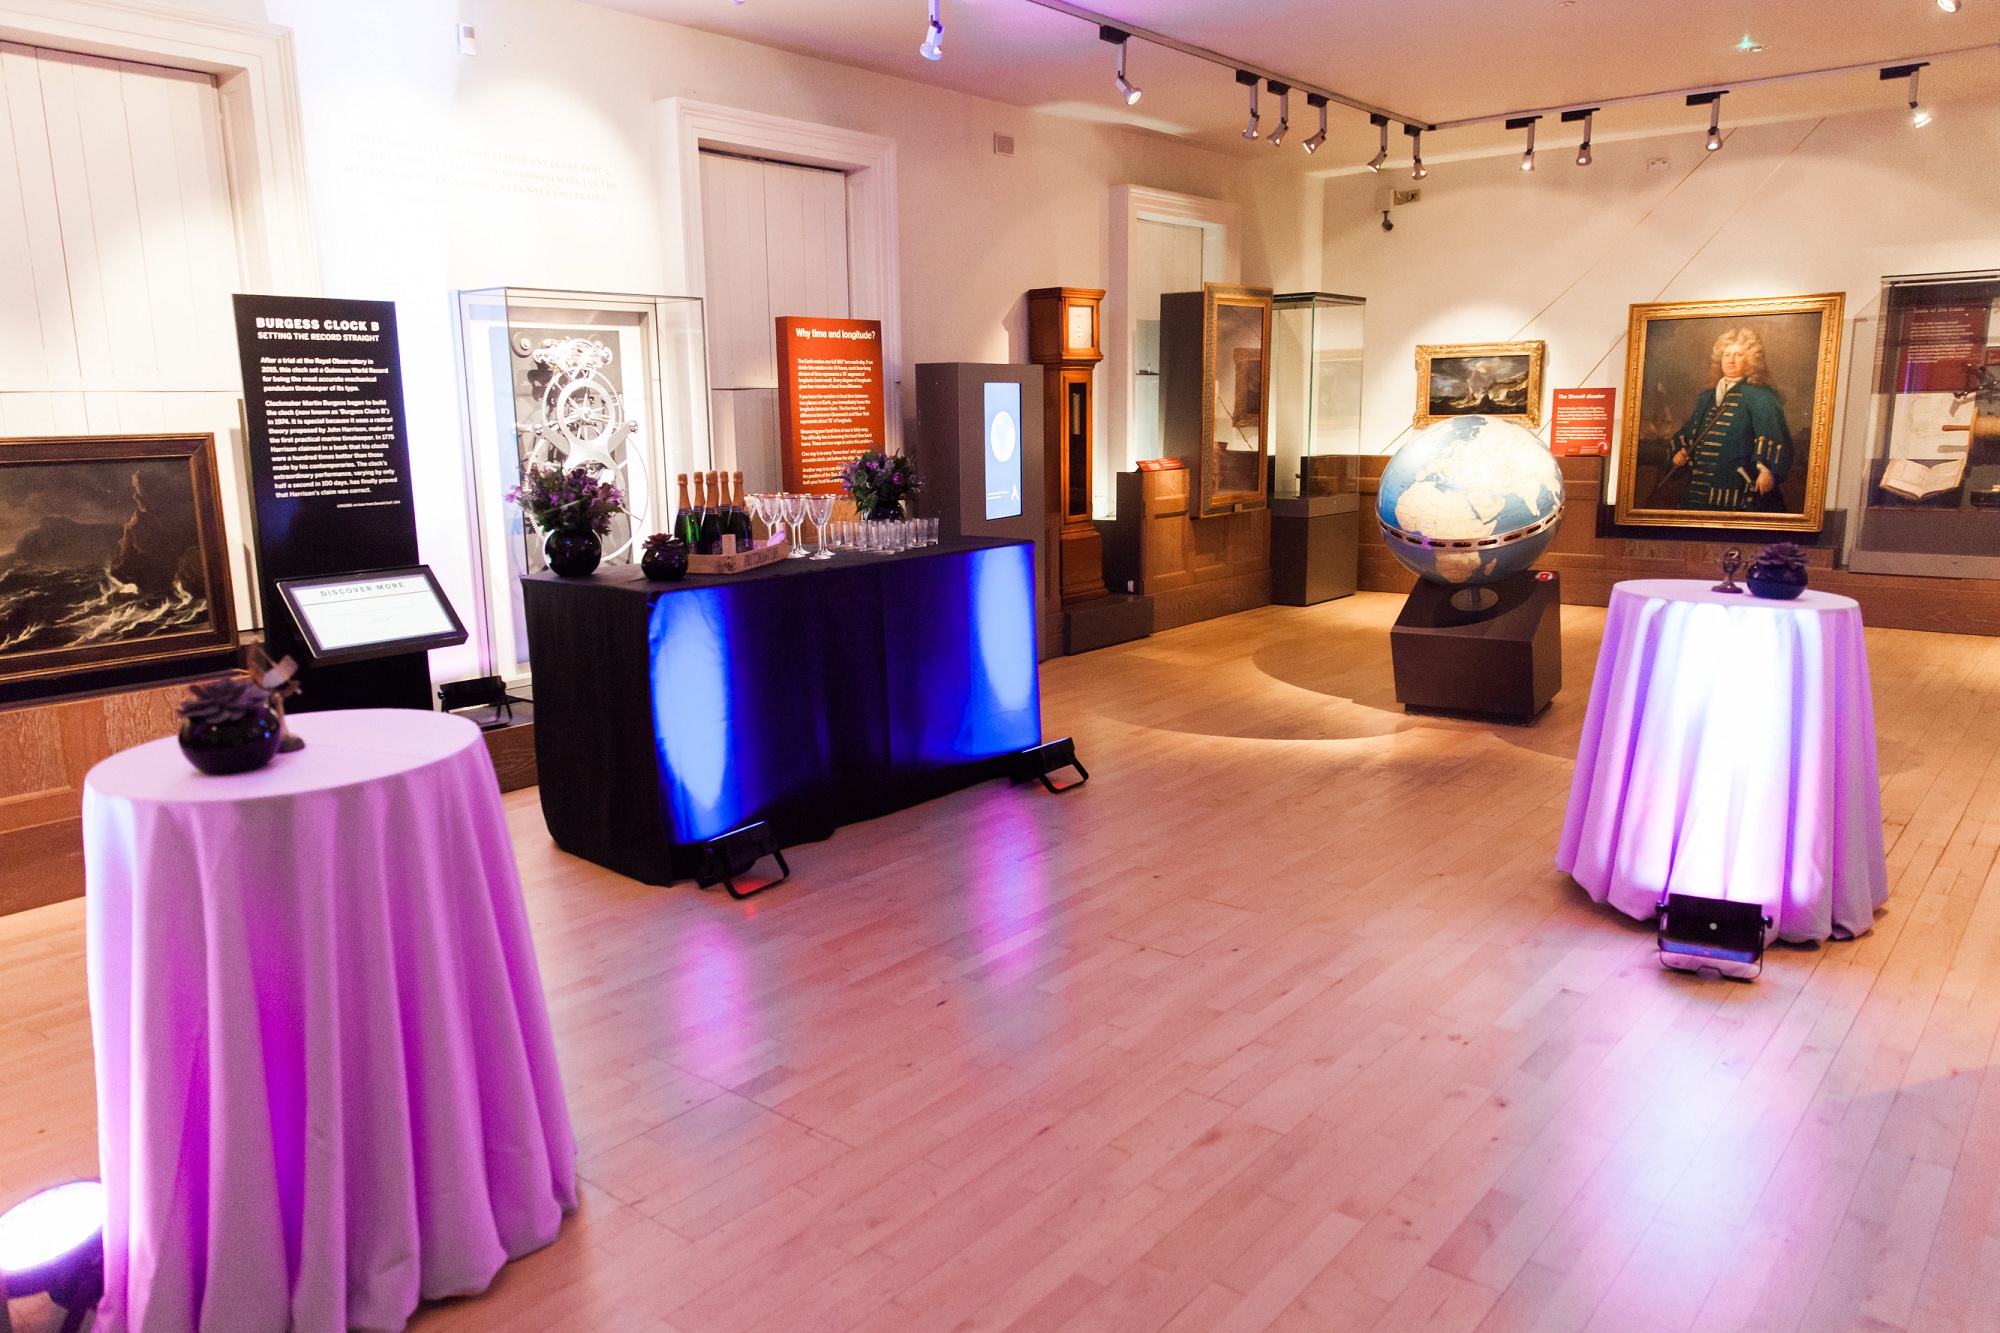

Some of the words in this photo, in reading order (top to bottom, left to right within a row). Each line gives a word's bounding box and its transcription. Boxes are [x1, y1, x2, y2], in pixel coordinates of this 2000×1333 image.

[492, 152, 527, 163] BEYOND
[551, 161, 577, 170] DOUBT
[580, 165, 602, 174] THAT
[557, 175, 581, 185] MADE
[583, 179, 599, 188] FOR
[601, 181, 617, 190] THE
[526, 186, 544, 195] NOT
[256, 317, 320, 330] BURGESS
[324, 320, 367, 331] CLOCK
[371, 322, 380, 331] B
[257, 332, 292, 340] SETTING
[310, 333, 342, 341] RECORD
[796, 328, 810, 339] Why
[812, 329, 827, 338] time
[828, 330, 841, 338] and
[842, 330, 875, 340] longitude?
[320, 586, 373, 597] DISCOVER
[377, 582, 405, 590] MORE
